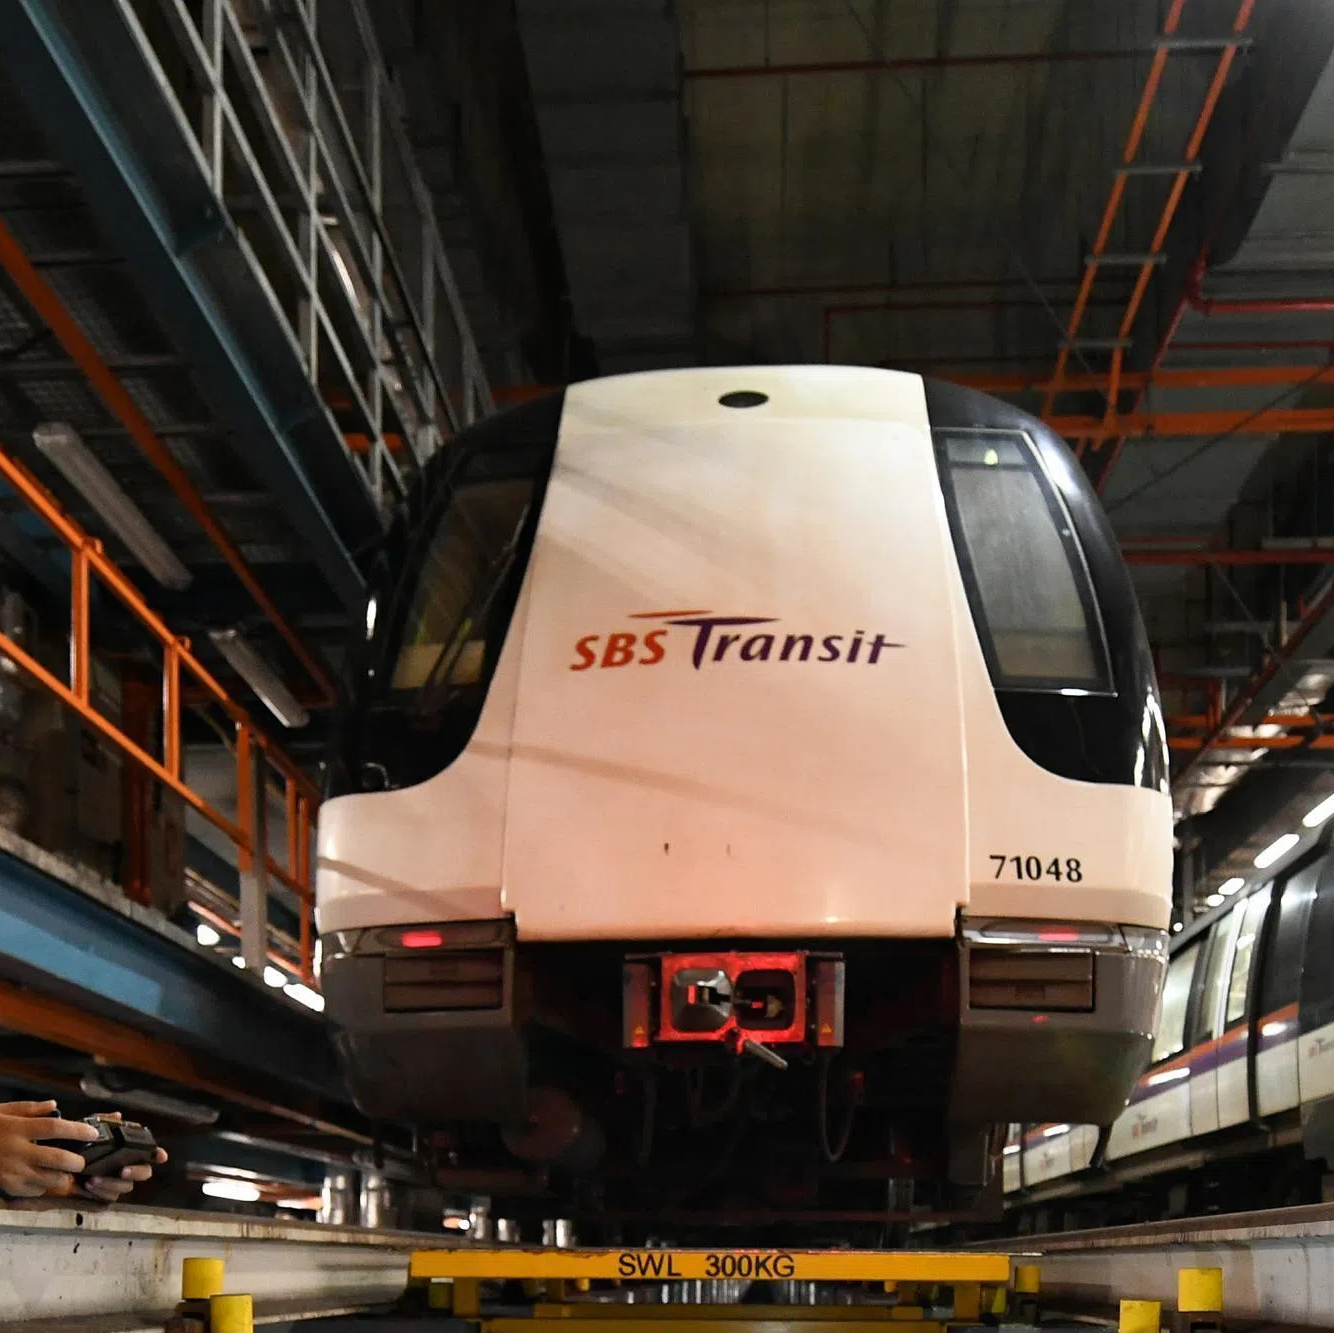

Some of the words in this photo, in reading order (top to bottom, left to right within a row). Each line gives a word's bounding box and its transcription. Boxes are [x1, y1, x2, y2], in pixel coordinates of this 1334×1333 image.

[570, 629, 669, 671] SBS
[663, 616, 908, 670] Transit
[989, 854, 1083, 882] 71048
[618, 1253, 682, 1277] SWL
[705, 1254, 795, 1278] 300KG
